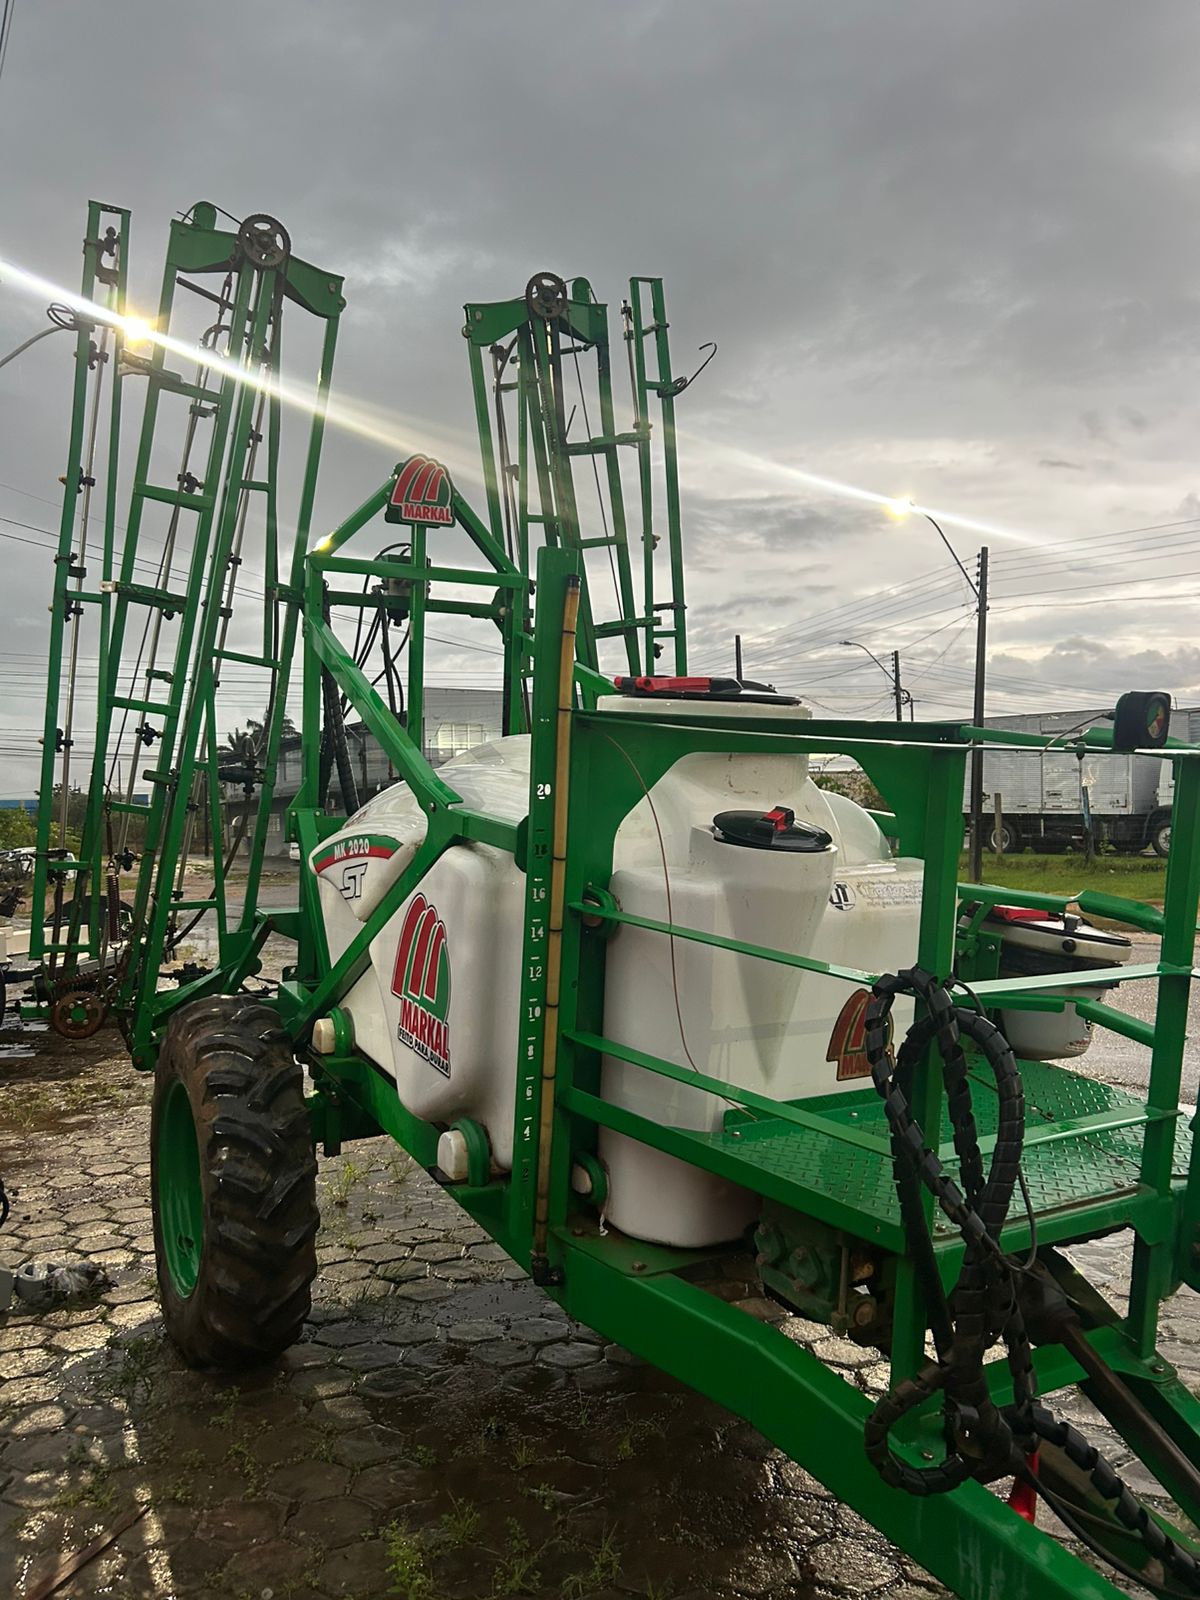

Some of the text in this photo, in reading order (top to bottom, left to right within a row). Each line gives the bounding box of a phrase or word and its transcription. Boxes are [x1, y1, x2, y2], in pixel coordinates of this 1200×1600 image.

[403, 503, 452, 522] MARKAL
[536, 783, 552, 796] 20
[333, 838, 370, 861] MK 2020
[532, 887, 546, 899] 16
[530, 926, 544, 939] 14
[529, 966, 542, 978] 12
[528, 1006, 541, 1018] 10
[400, 998, 449, 1062] MARKAL
[399, 1027, 450, 1073] FEITO PARA DURAR
[527, 1045, 534, 1057] 8
[526, 1085, 533, 1097] 6
[523, 1125, 531, 1138] 4
